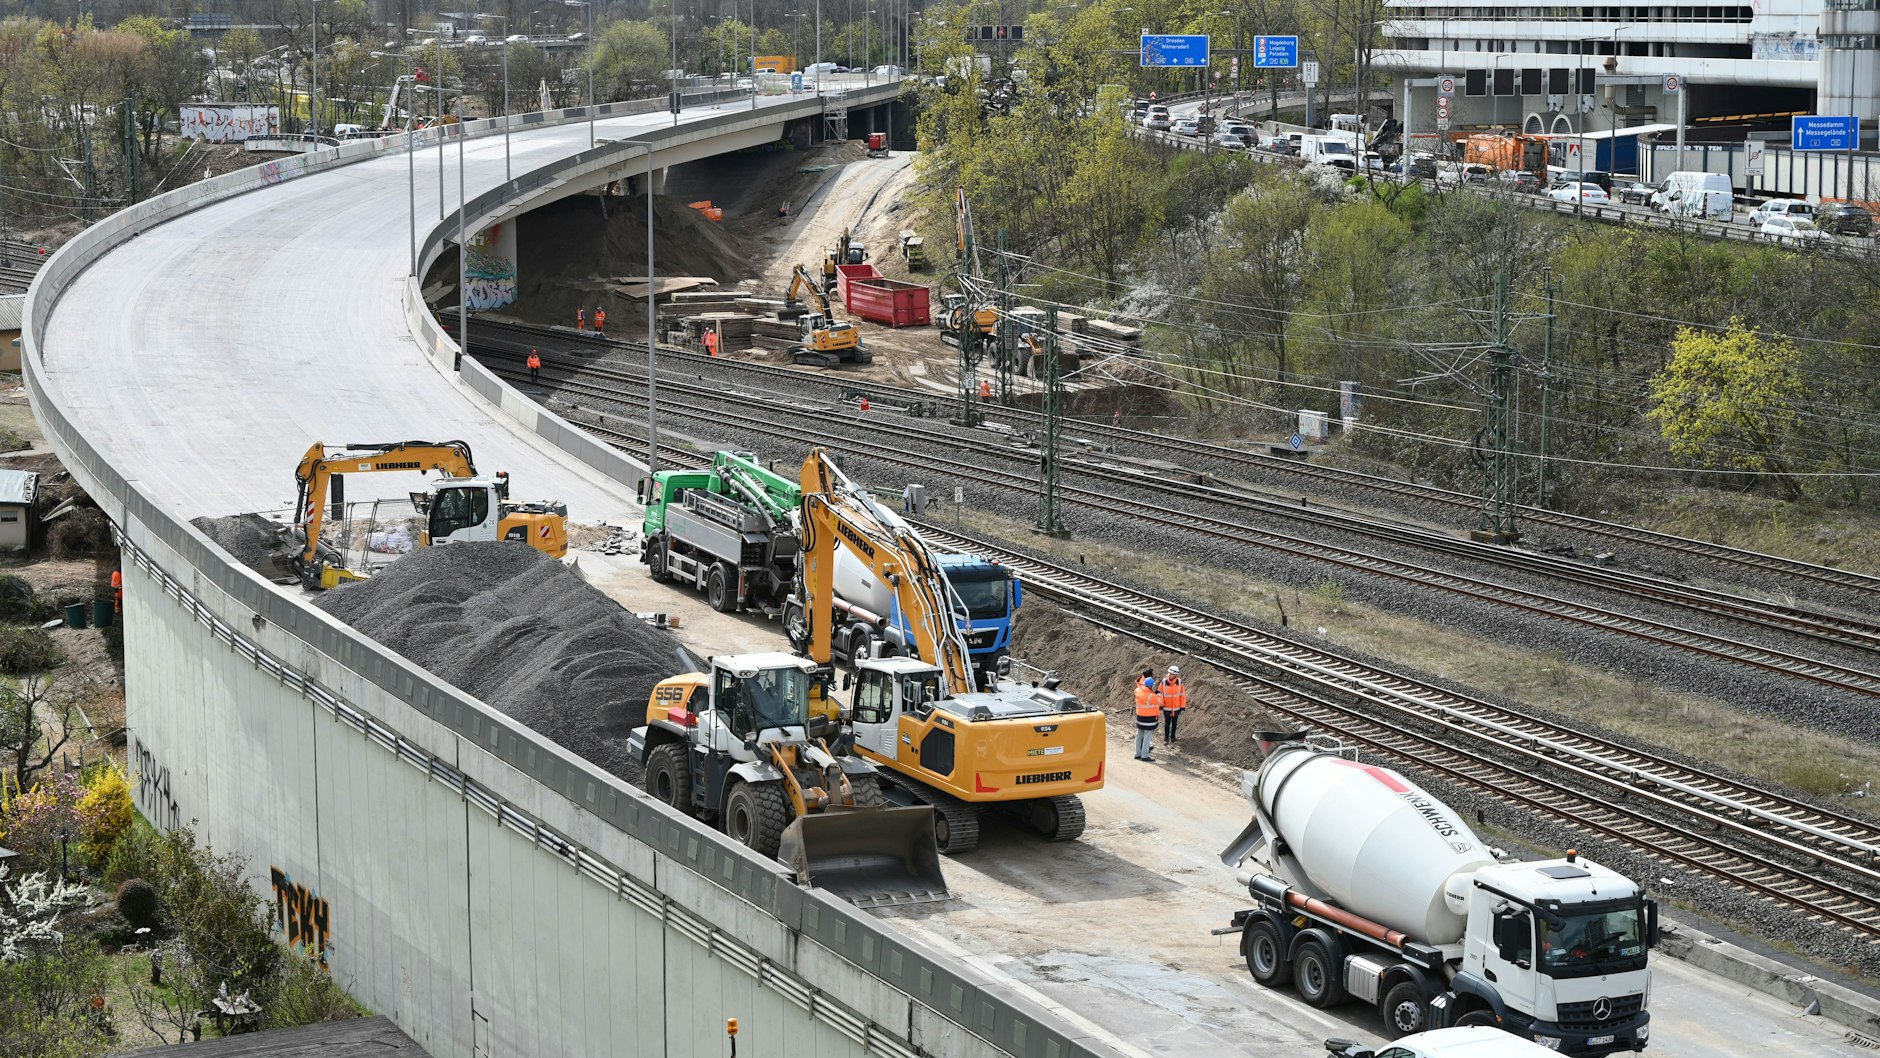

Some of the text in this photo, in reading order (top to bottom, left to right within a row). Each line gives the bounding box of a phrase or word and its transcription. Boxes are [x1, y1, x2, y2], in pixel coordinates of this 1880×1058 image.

[1806, 129, 1846, 137] Messegelände
[375, 461, 421, 469] LIEBHERR
[837, 520, 874, 559] LIEBHERR
[656, 687, 683, 700] 556
[1027, 748, 1044, 756] MIETE
[1015, 771, 1072, 785] LIEBHERR
[1399, 791, 1459, 837] SCHWENK
[270, 864, 330, 974] TEKY
